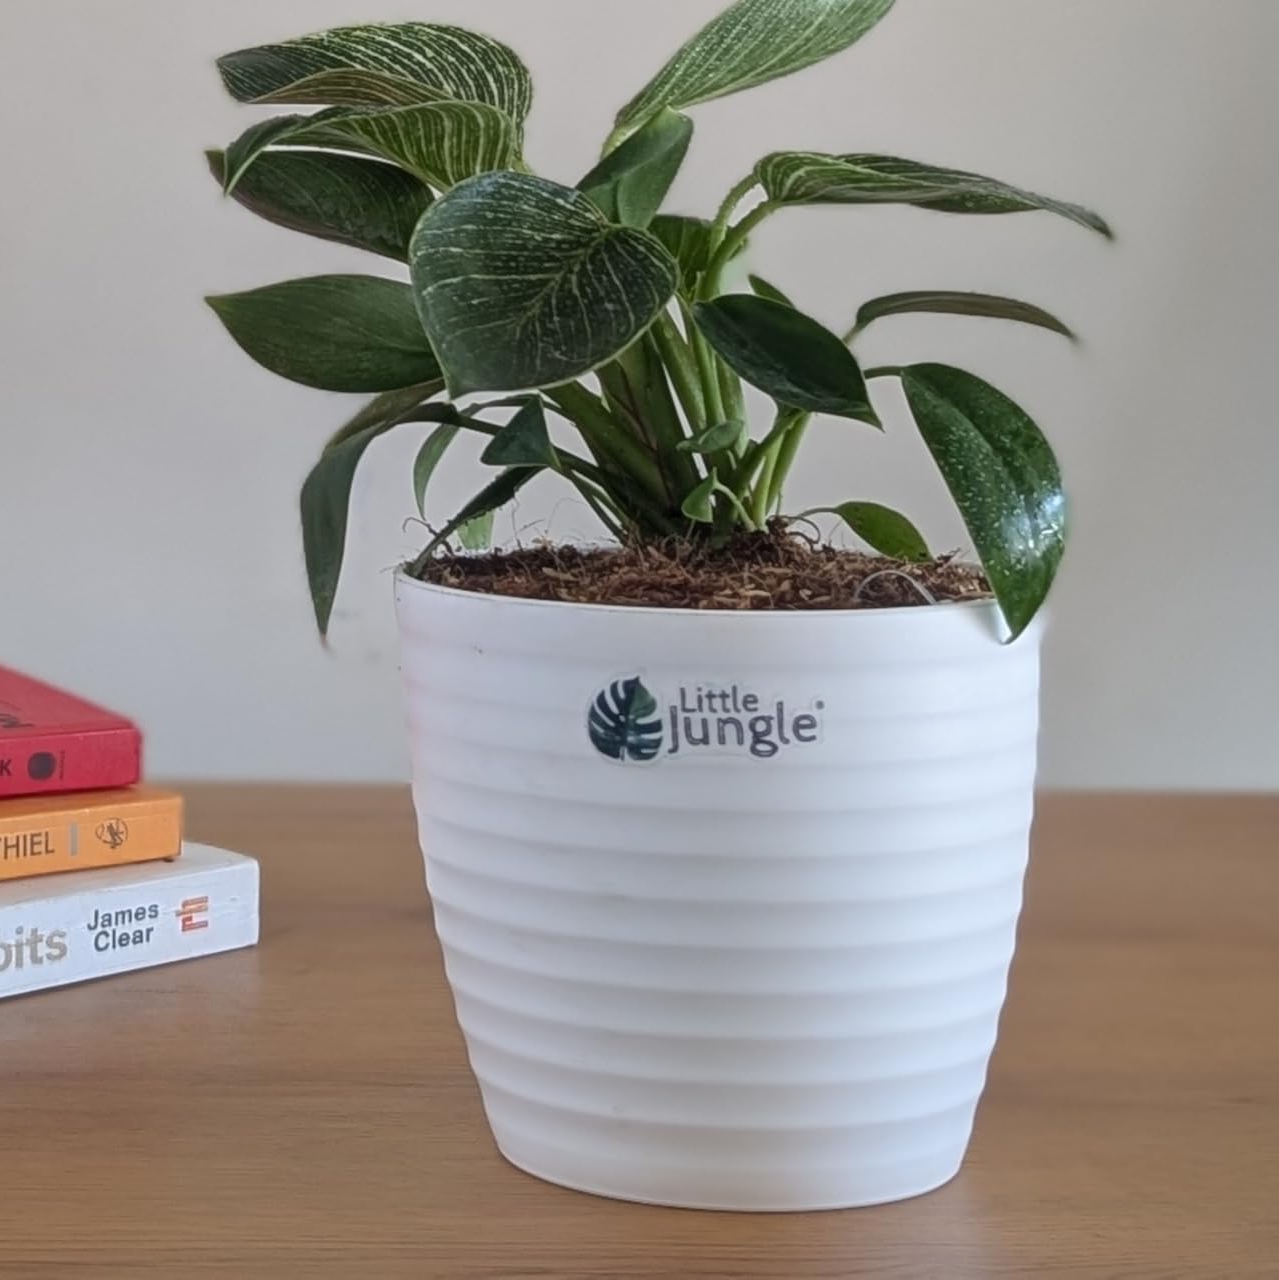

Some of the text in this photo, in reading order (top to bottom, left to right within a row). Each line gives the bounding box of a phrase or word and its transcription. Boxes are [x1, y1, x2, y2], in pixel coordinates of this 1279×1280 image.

[680, 685, 759, 713] Little
[667, 701, 818, 757] Jungle
[87, 903, 159, 931] James
[94, 926, 154, 952] Clear
